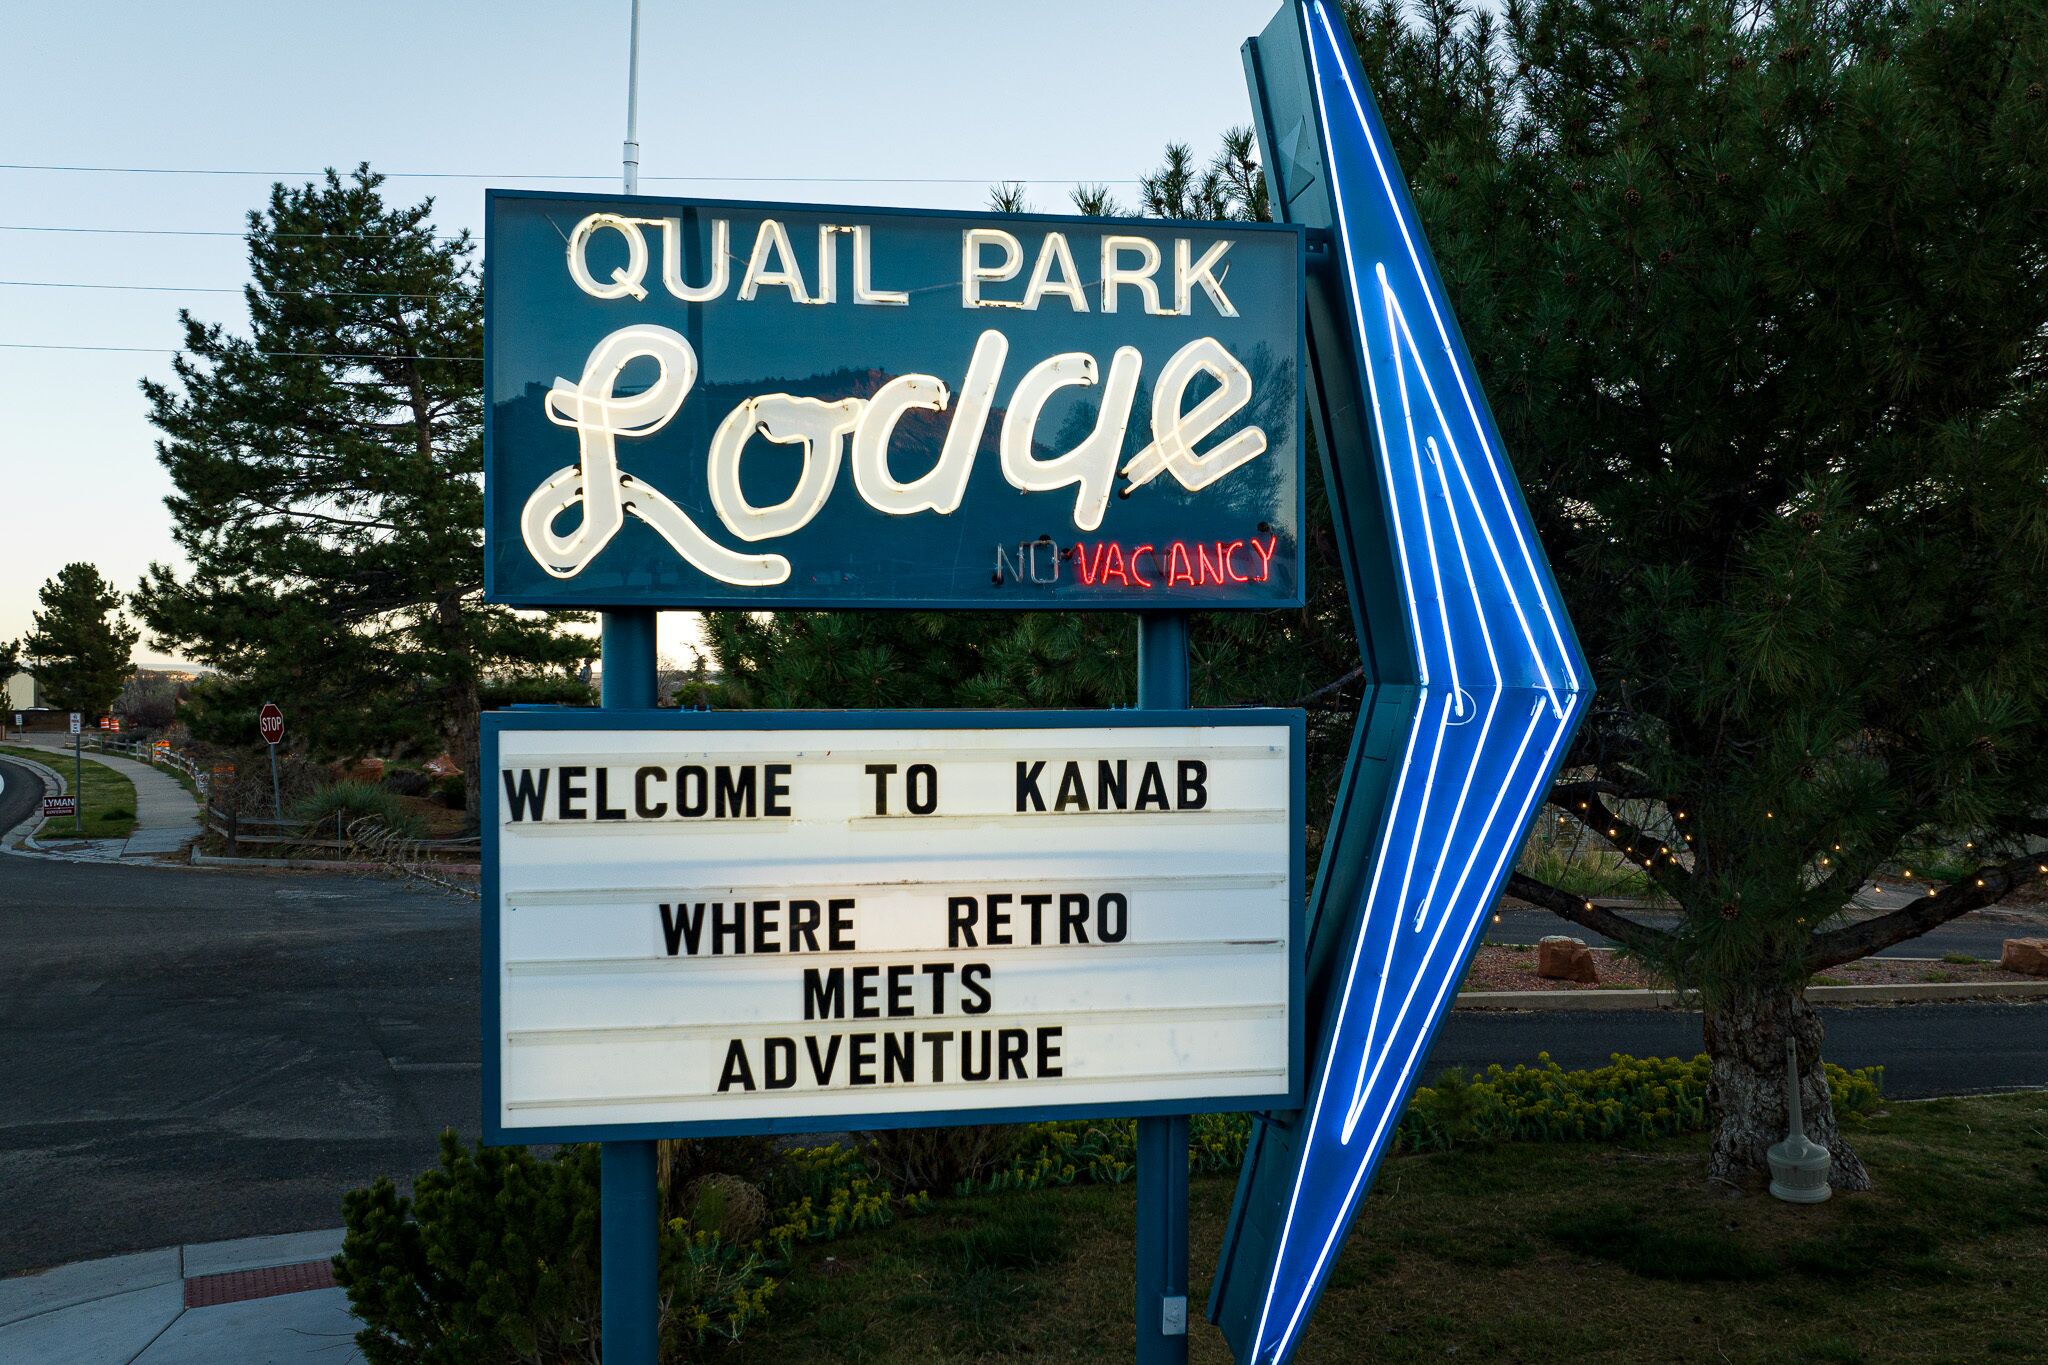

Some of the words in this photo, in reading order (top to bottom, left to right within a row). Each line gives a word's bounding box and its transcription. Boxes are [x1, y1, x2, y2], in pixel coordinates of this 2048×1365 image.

[566, 211, 909, 307] QUAIL
[961, 228, 1240, 318] PARK
[520, 323, 1268, 587] Lodge
[997, 539, 1059, 584] NO
[1076, 535, 1277, 587] VACANCY
[262, 716, 282, 732] STOP
[44, 798, 75, 808] LYMAN
[502, 763, 792, 823] WELCOME
[865, 763, 938, 817] TO
[1015, 758, 1209, 813] KANAB
[659, 898, 856, 956] WHERE
[947, 891, 1129, 949] RETRO
[803, 962, 992, 1021] MEETS
[716, 1025, 1064, 1093] ADVENTURE
